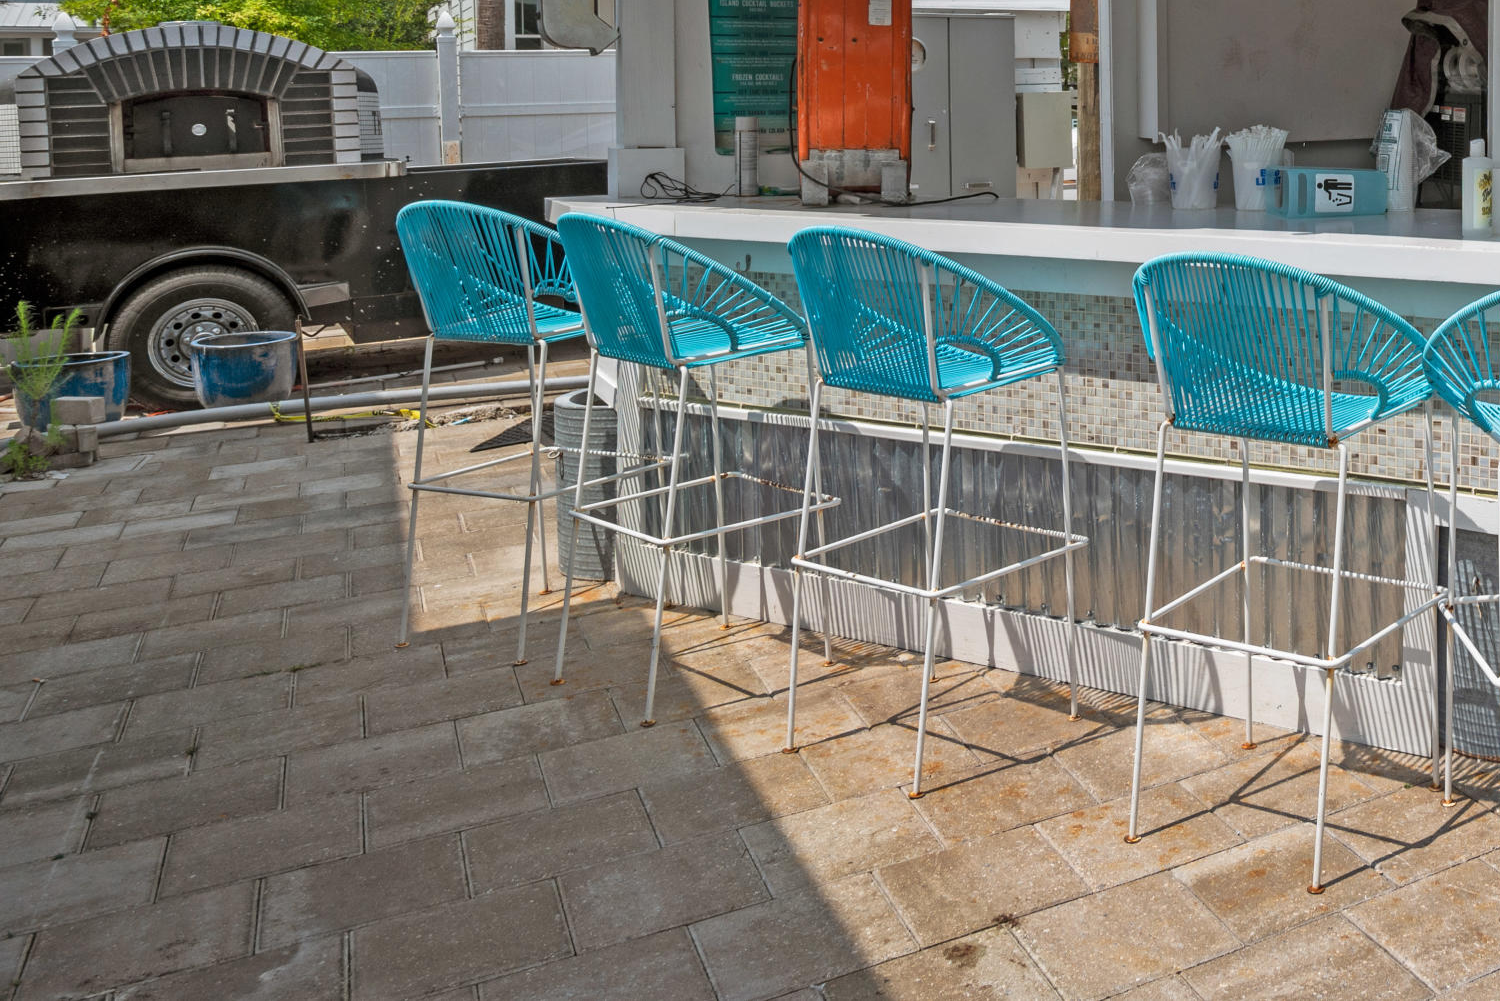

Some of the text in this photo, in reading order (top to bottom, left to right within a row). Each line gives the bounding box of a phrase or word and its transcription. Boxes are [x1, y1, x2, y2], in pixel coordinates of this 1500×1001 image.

[741, 0, 767, 8] COCKTAIL
[731, 73, 784, 81] FROZEN COCKTAILS
